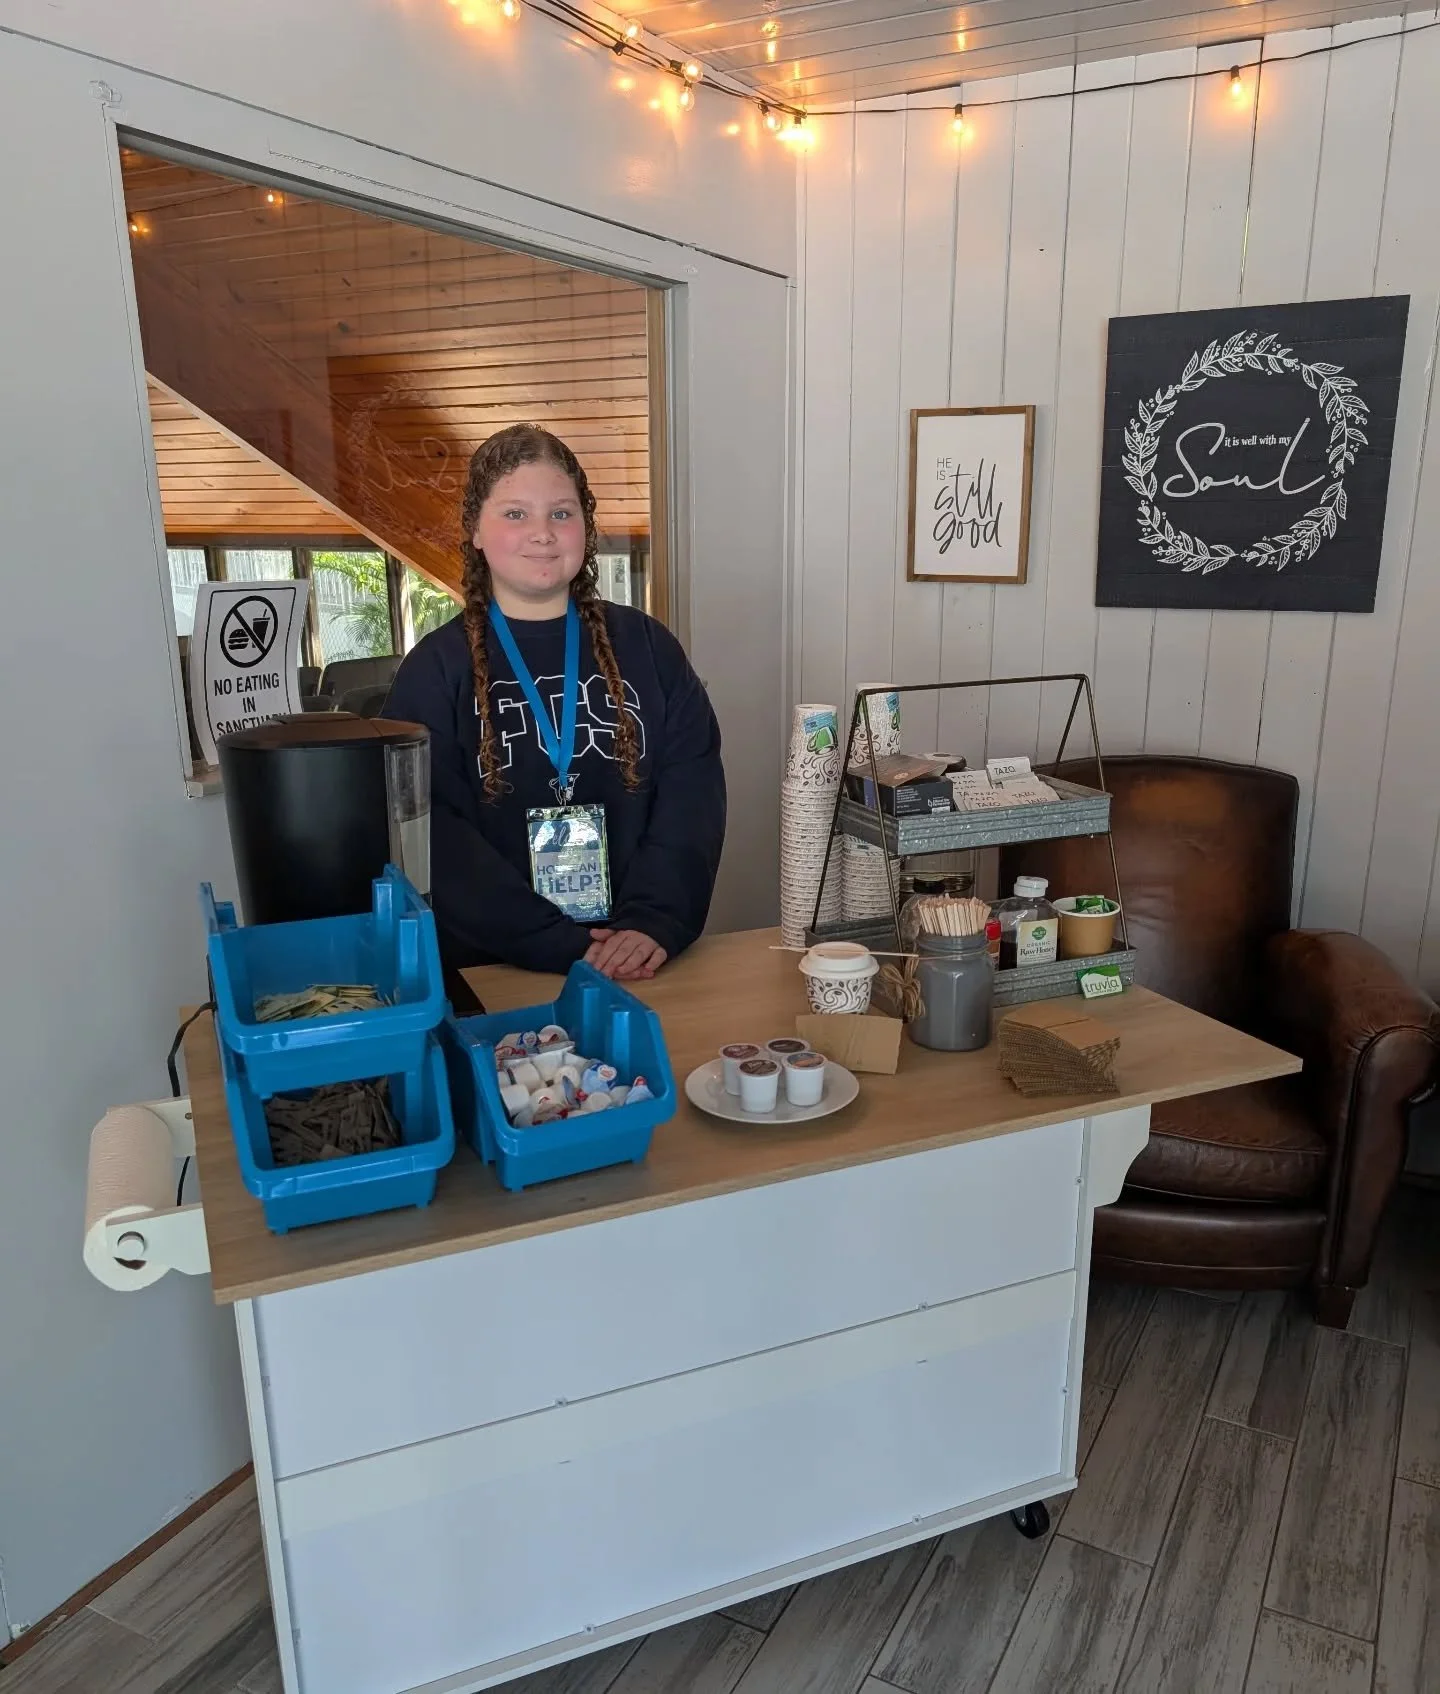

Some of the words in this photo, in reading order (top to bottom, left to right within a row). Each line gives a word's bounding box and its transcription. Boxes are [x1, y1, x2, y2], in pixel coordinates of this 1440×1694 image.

[1224, 436, 1232, 448] it
[1232, 436, 1240, 446] is
[1241, 434, 1258, 446] well
[1259, 434, 1277, 446] with
[1278, 436, 1292, 447] my
[936, 457, 952, 469] HE
[1162, 417, 1326, 498] Soul
[936, 470, 946, 481] IS
[934, 457, 997, 519] still
[932, 501, 1003, 554] good
[213, 678, 232, 697] NO
[236, 672, 280, 693] EATING
[242, 696, 256, 713] IN
[993, 765, 1017, 775] TAZO
[1019, 947, 1035, 956] Raw
[1035, 945, 1055, 954] Honey
